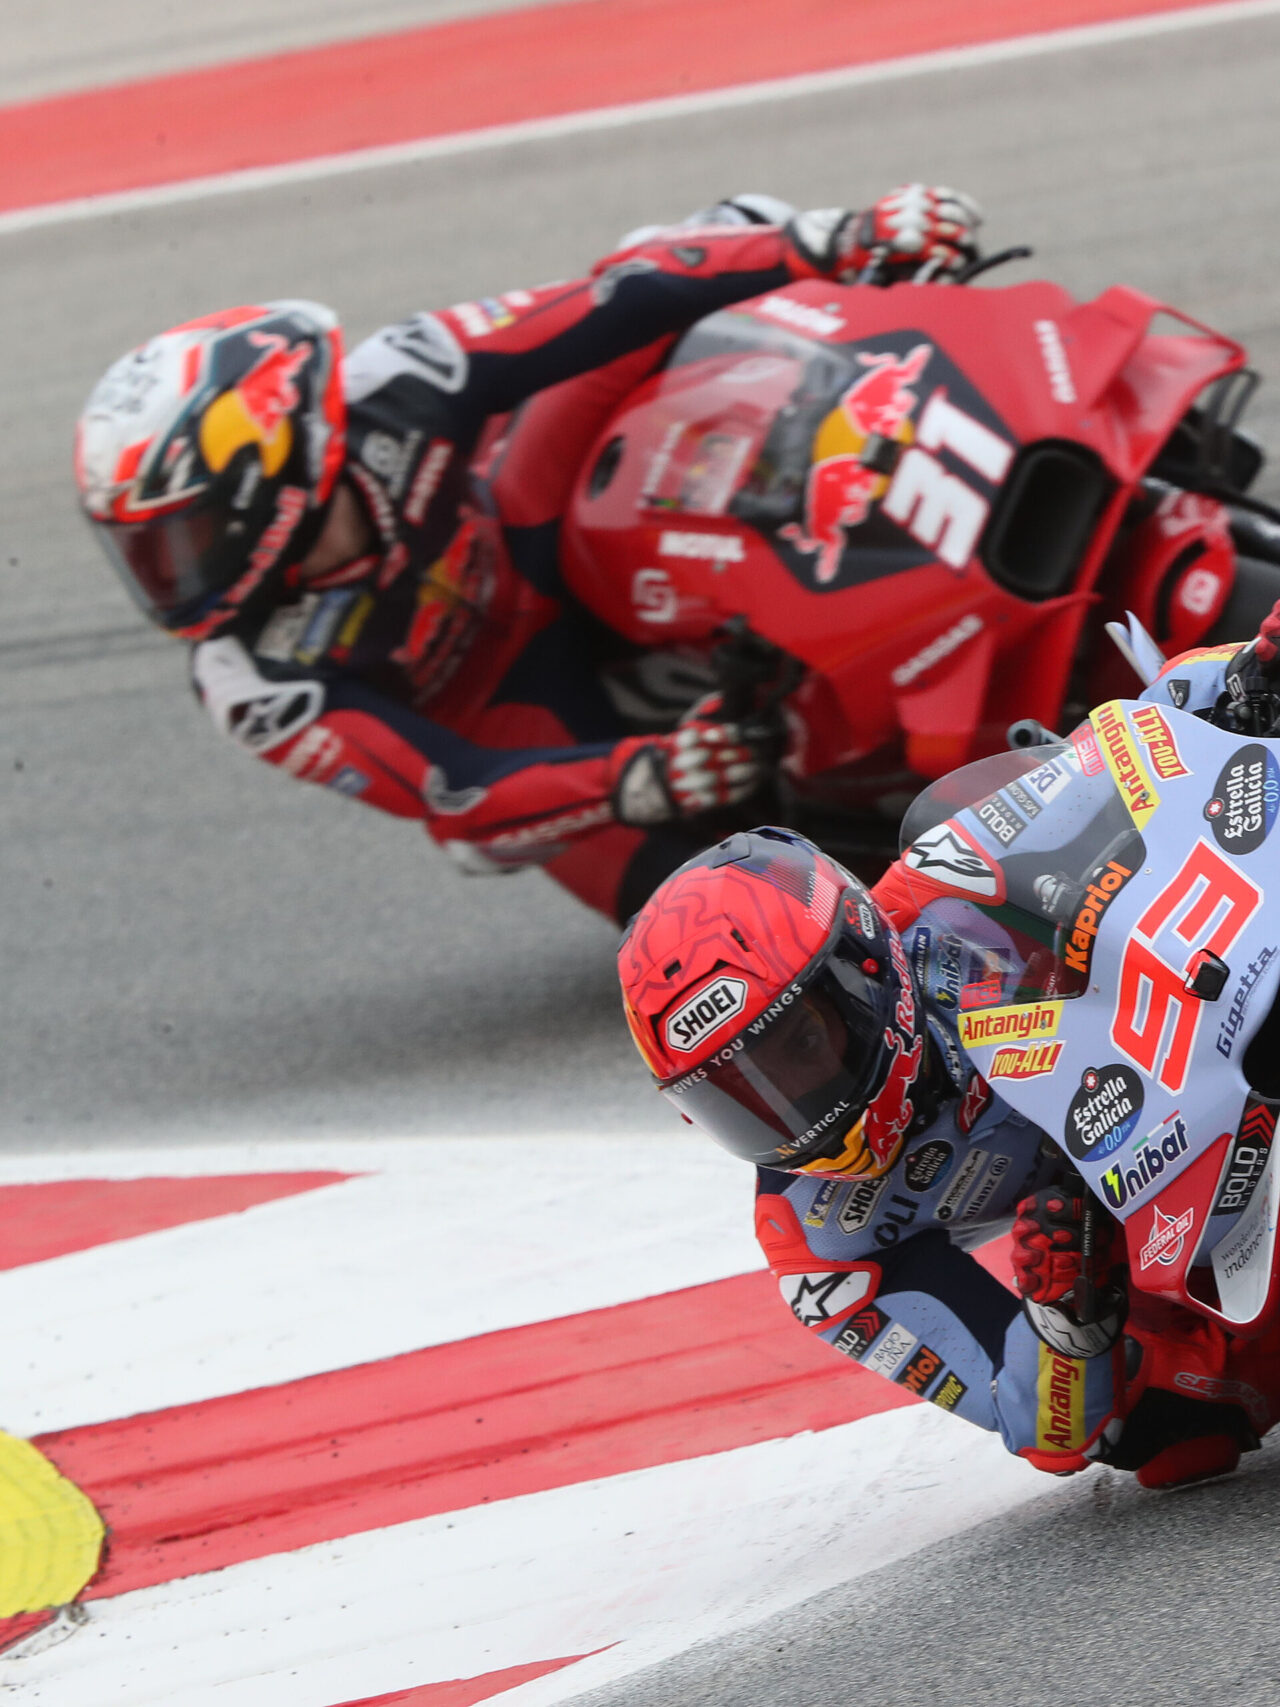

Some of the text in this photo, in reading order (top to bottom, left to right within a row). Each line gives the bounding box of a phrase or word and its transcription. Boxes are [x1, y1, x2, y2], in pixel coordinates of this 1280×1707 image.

[881, 391, 1015, 571] 31
[1097, 706, 1154, 812] Antangin
[1131, 708, 1184, 779] YOU-ALL
[980, 803, 1017, 842] BOLD
[1224, 763, 1246, 840] Estrella
[1240, 761, 1263, 838] Galicia
[1065, 861, 1132, 972] Kapriol
[1111, 836, 1264, 1096] 93
[672, 985, 738, 1044] SHOEI
[962, 1005, 1054, 1042] Antangin
[1216, 945, 1278, 1060] Gigetta
[672, 983, 803, 1095] GIVES YOU WINGS
[992, 1043, 1060, 1078] YOU-ALL
[790, 1100, 850, 1150] VERTICAL
[1074, 1073, 1128, 1130] Estrella
[1080, 1097, 1133, 1146] Galicia
[1100, 1118, 1190, 1209] Unibat
[1219, 1147, 1258, 1208] BOLD
[845, 1178, 888, 1225] SHOE
[1144, 1216, 1190, 1263] FEDERAL OIL
[834, 1329, 860, 1354] OLD
[1043, 1346, 1081, 1450] Antangi
